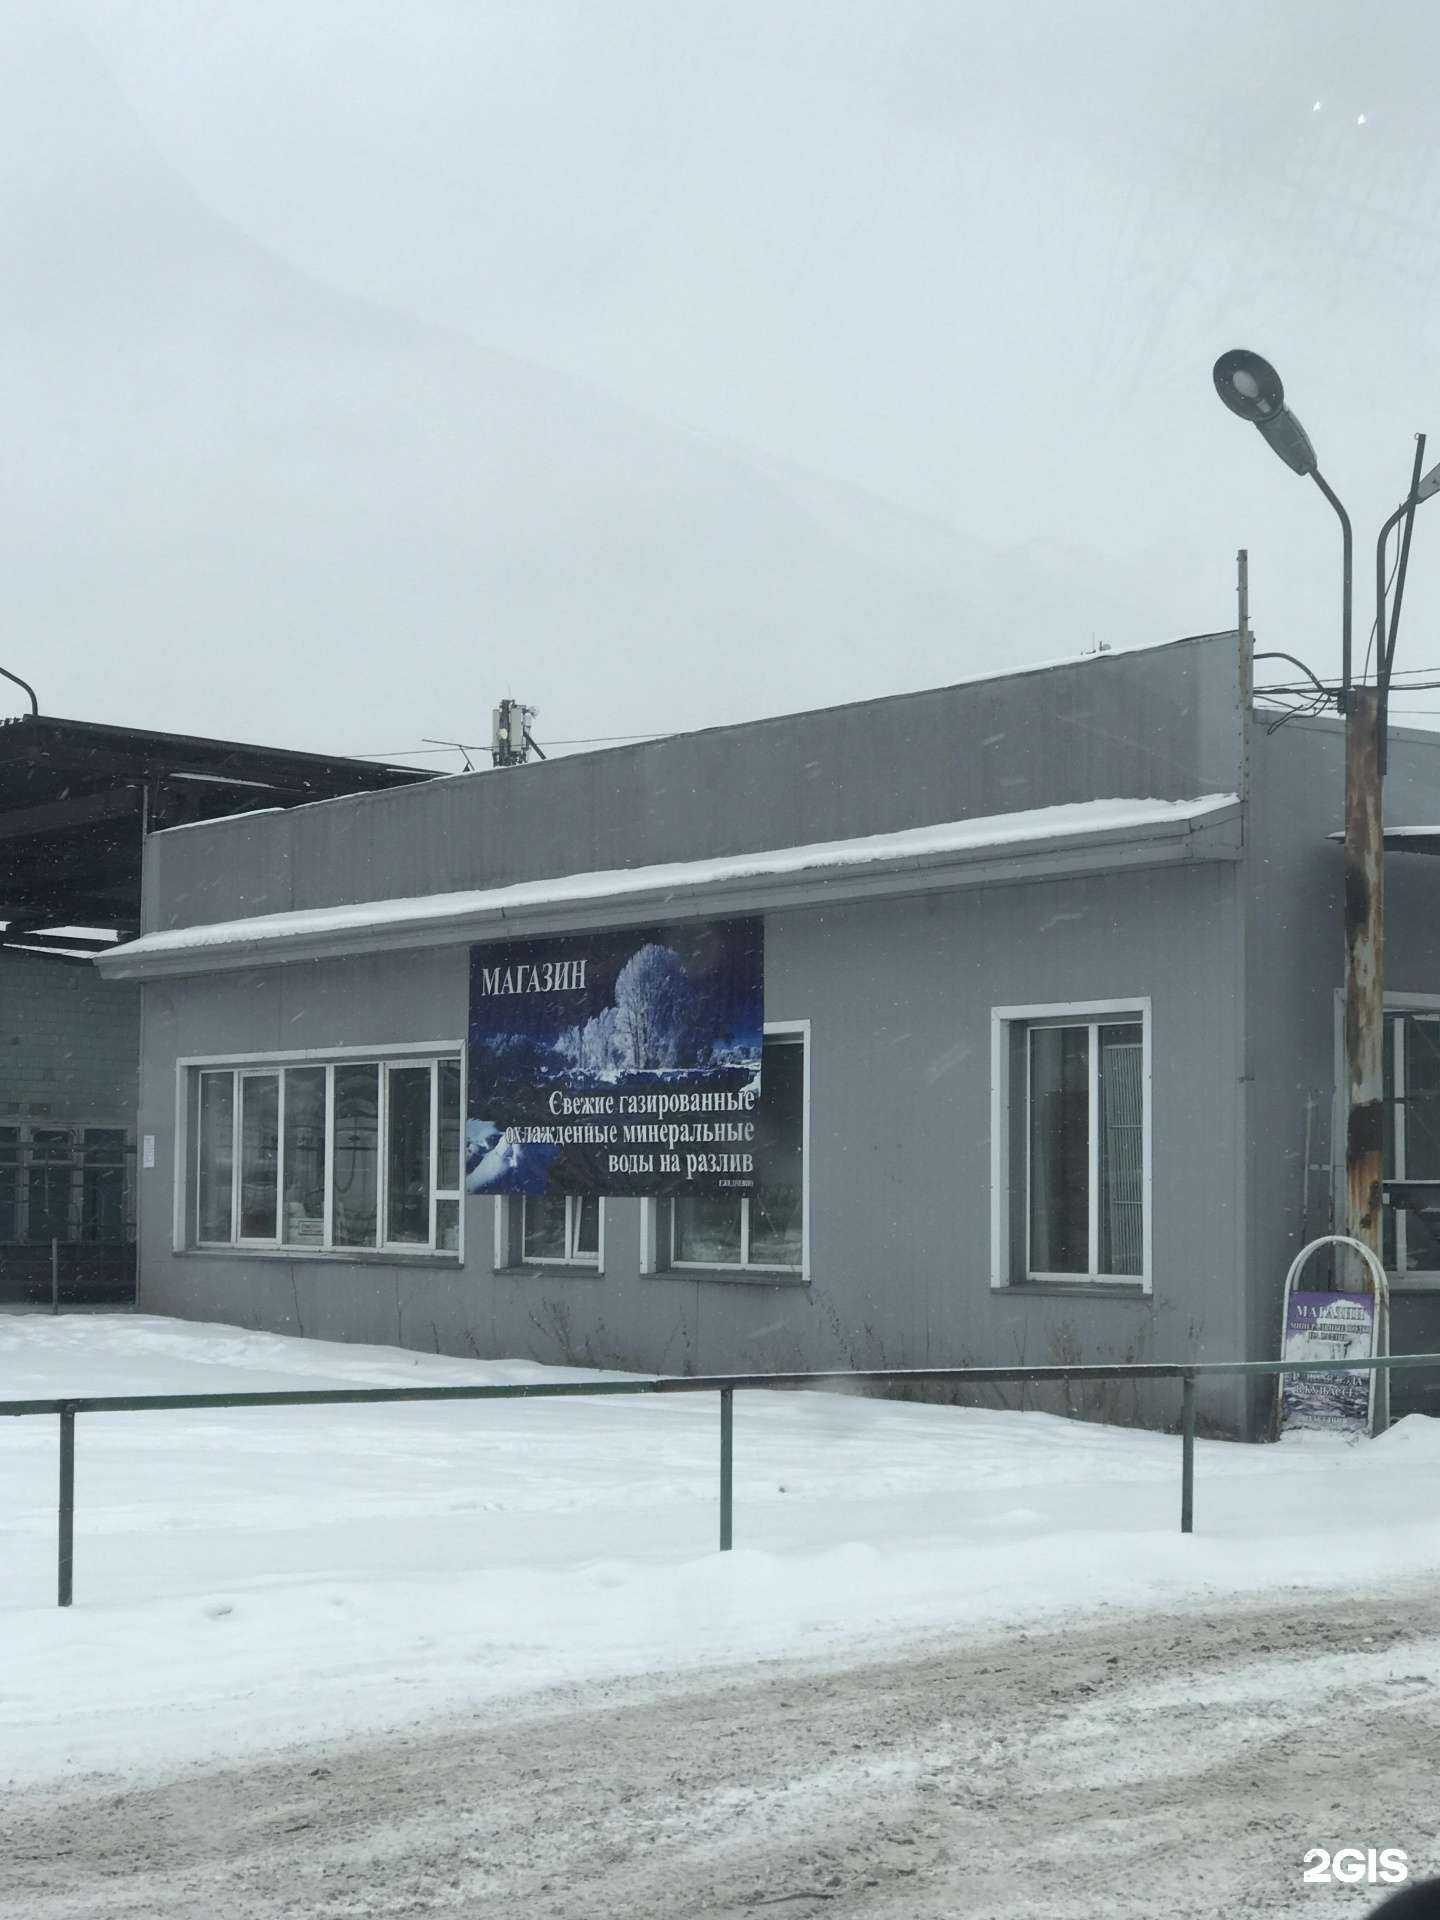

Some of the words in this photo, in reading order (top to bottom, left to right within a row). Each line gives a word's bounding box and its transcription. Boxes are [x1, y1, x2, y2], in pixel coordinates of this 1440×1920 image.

[481, 960, 588, 996] МАГАЗИН
[548, 1090, 614, 1115] Свежие
[619, 1089, 755, 1120] газированные
[505, 1124, 618, 1147] охлажденные
[623, 1121, 755, 1150] минеральные
[608, 1153, 654, 1174] воды
[660, 1153, 681, 1172] на
[686, 1153, 754, 1180] разлив
